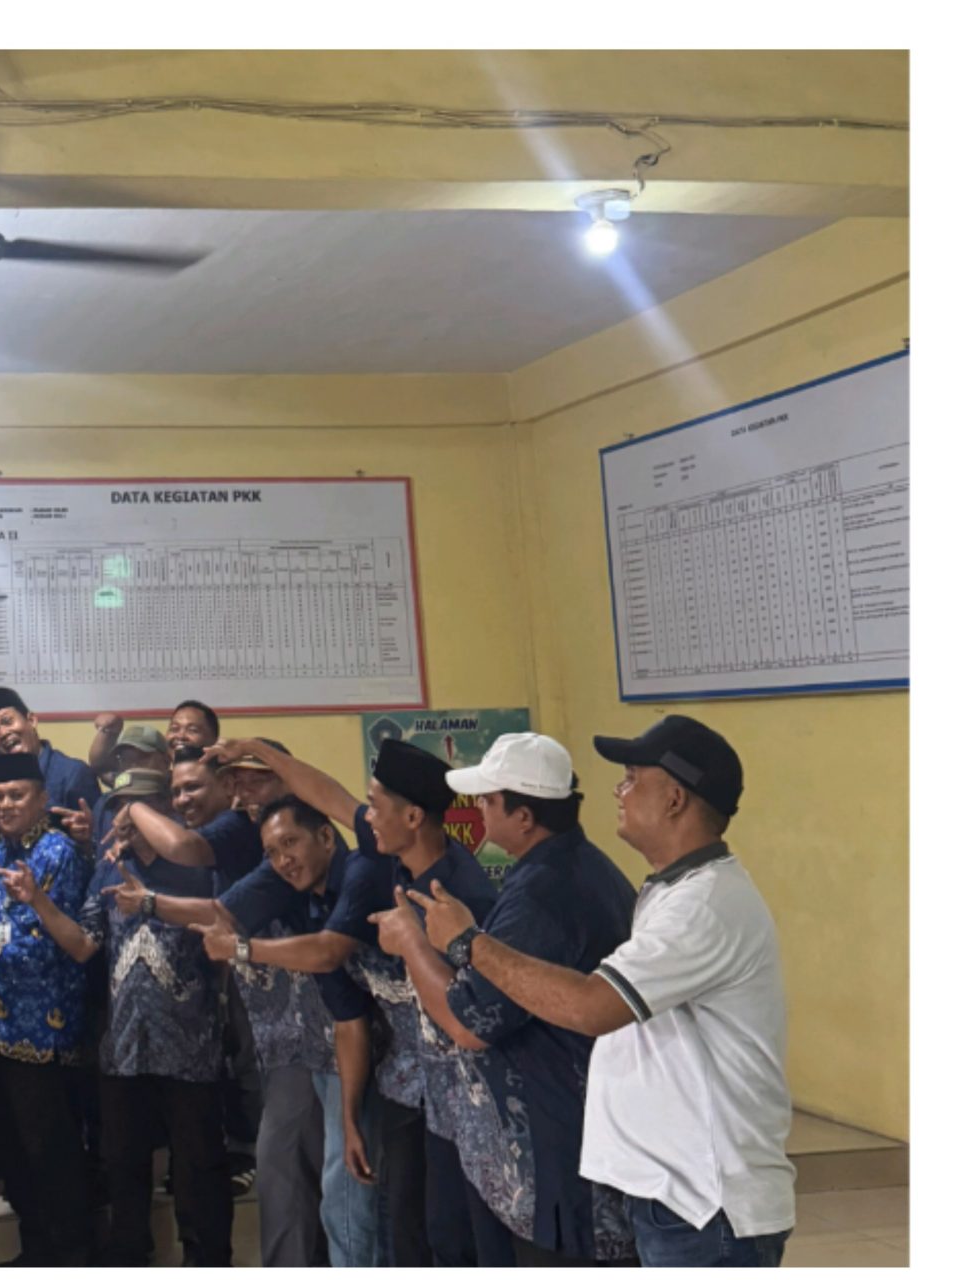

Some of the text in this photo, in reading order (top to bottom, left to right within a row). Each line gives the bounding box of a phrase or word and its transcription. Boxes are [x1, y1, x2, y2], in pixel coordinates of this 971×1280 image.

[111, 490, 262, 504] DATA KEGIATAN PKK
[415, 717, 479, 732] HALAMAN
